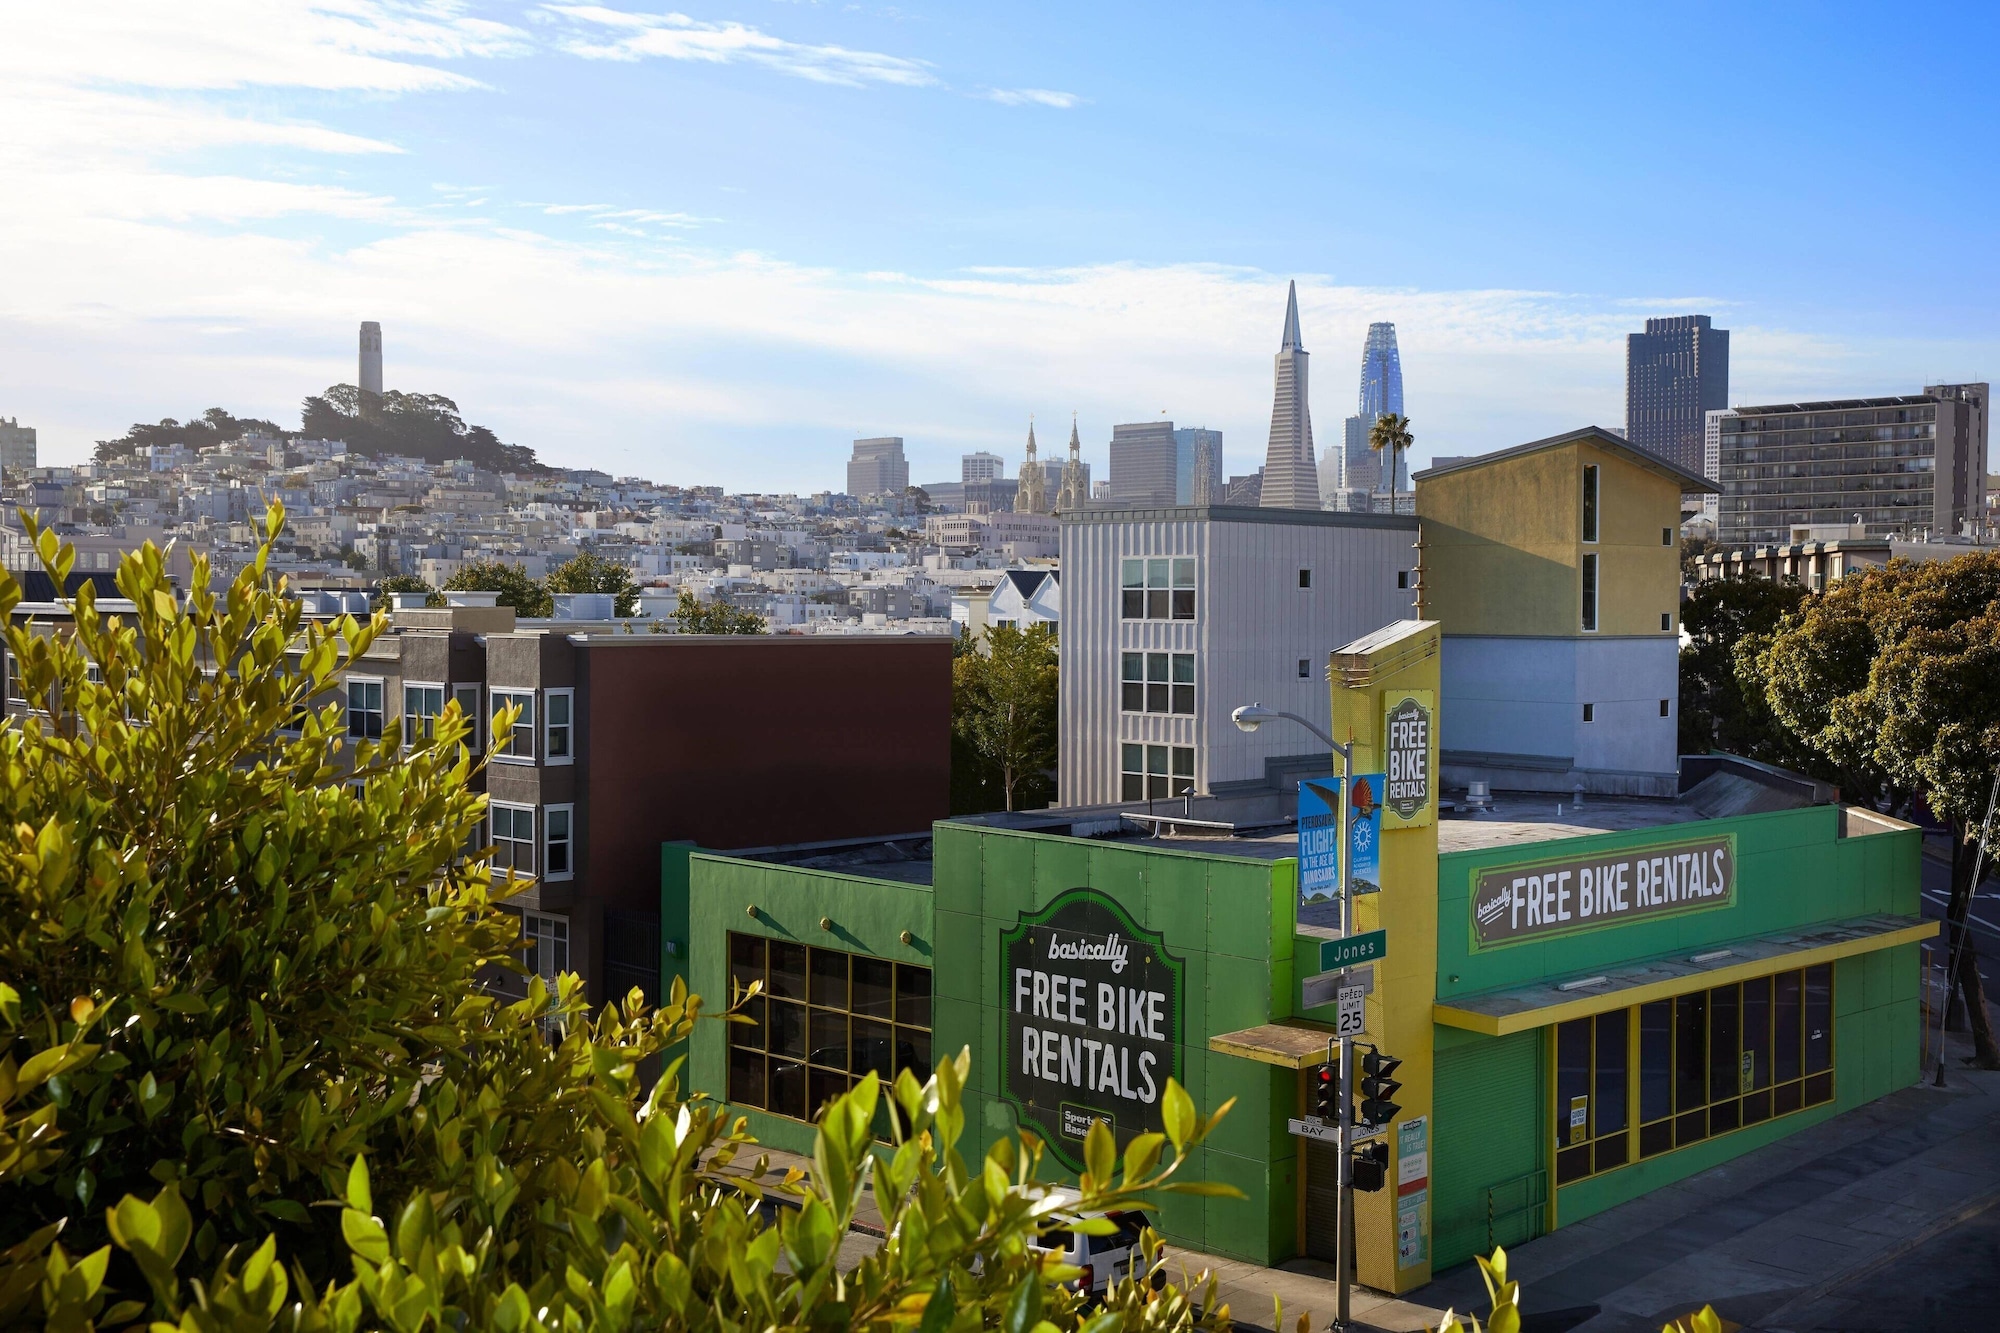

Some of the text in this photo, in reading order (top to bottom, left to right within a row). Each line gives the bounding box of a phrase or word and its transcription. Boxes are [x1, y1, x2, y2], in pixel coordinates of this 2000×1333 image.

[1390, 721, 1426, 749] FREE
[1390, 749, 1426, 781] BIKE
[1389, 781, 1426, 799] RENTALS
[1301, 814, 1334, 829] PTEROSAURS
[1302, 828, 1335, 856] FLIGHT
[1302, 853, 1334, 870] IN THE AGE OF
[1303, 867, 1336, 884] DINOSAURS
[1477, 849, 1725, 929] basically FREE BIKE RENTALS
[1048, 933, 1128, 974] basically
[1334, 941, 1375, 962] Jones
[1015, 968, 1166, 1041] FREE BIKE
[1339, 990, 1363, 1001] SPEED
[1342, 1001, 1360, 1011] LIMIT
[1340, 1011, 1362, 1032] 25
[1022, 1026, 1157, 1104] RENTALS
[1301, 1125, 1324, 1136] BAY
[1358, 1124, 1380, 1137] JONES
[1404, 1131, 1421, 1143] REALLY
[1406, 1144, 1412, 1153] IS
